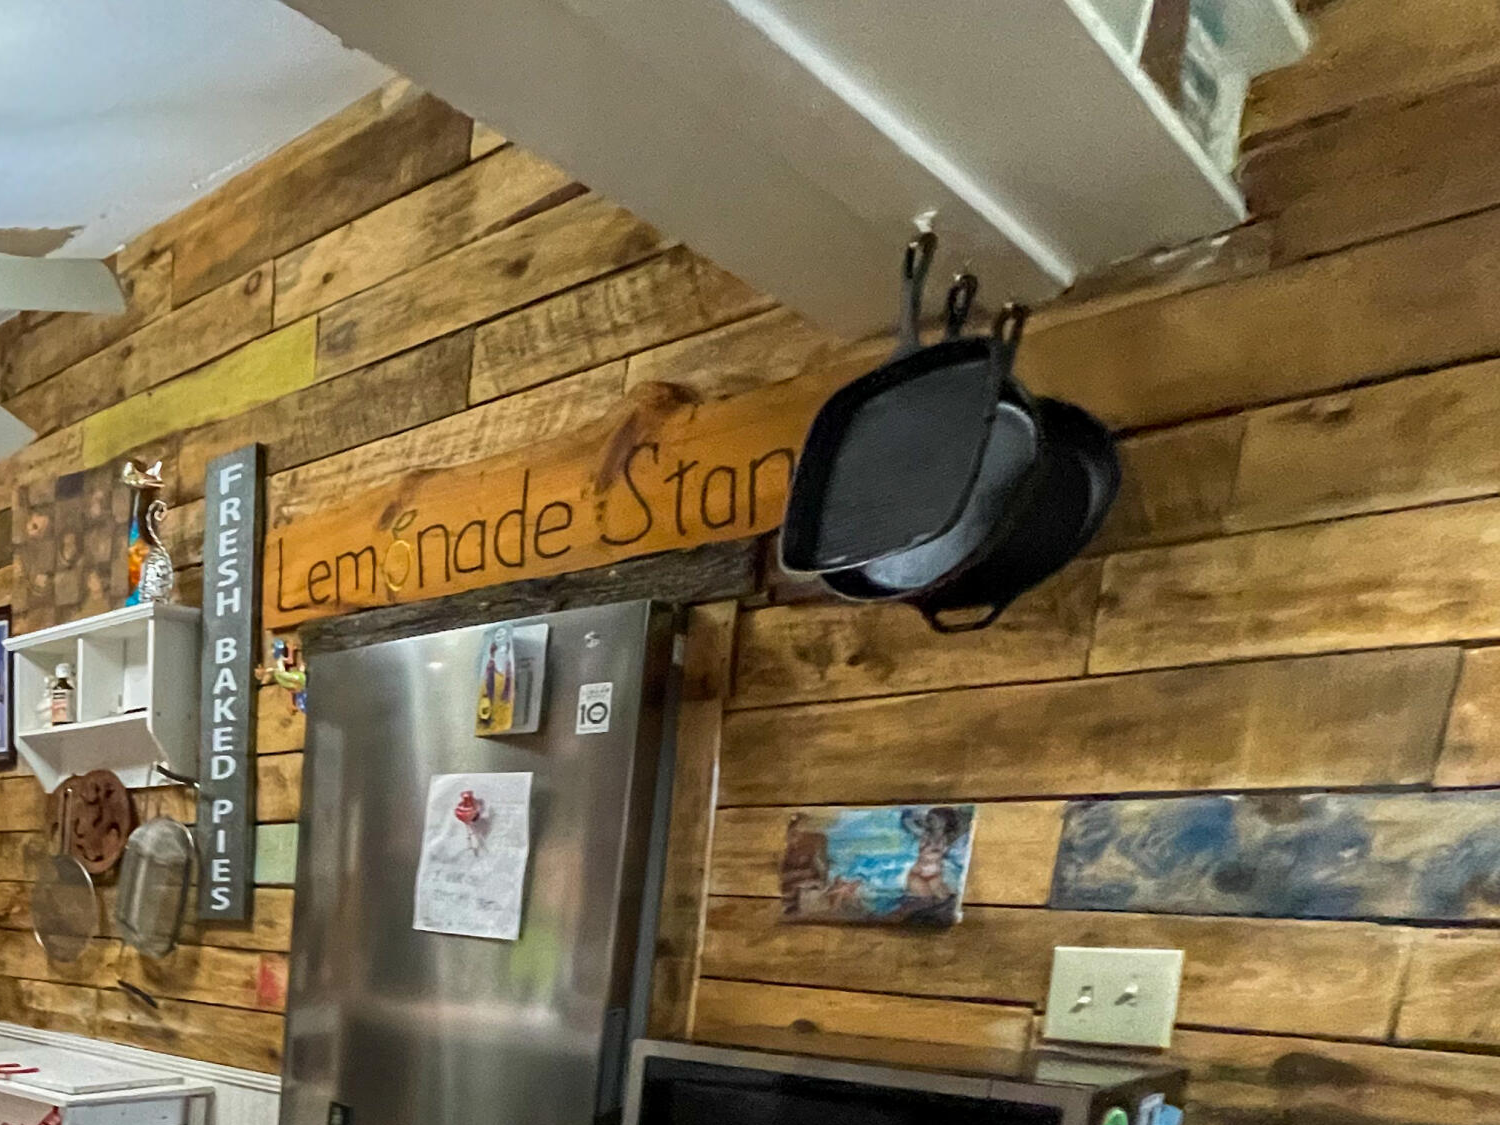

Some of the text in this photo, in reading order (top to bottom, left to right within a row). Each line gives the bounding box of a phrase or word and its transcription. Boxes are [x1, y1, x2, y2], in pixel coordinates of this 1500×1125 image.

[209, 462, 243, 912] FRESH BAKED PIES
[277, 468, 573, 613] Lemonade
